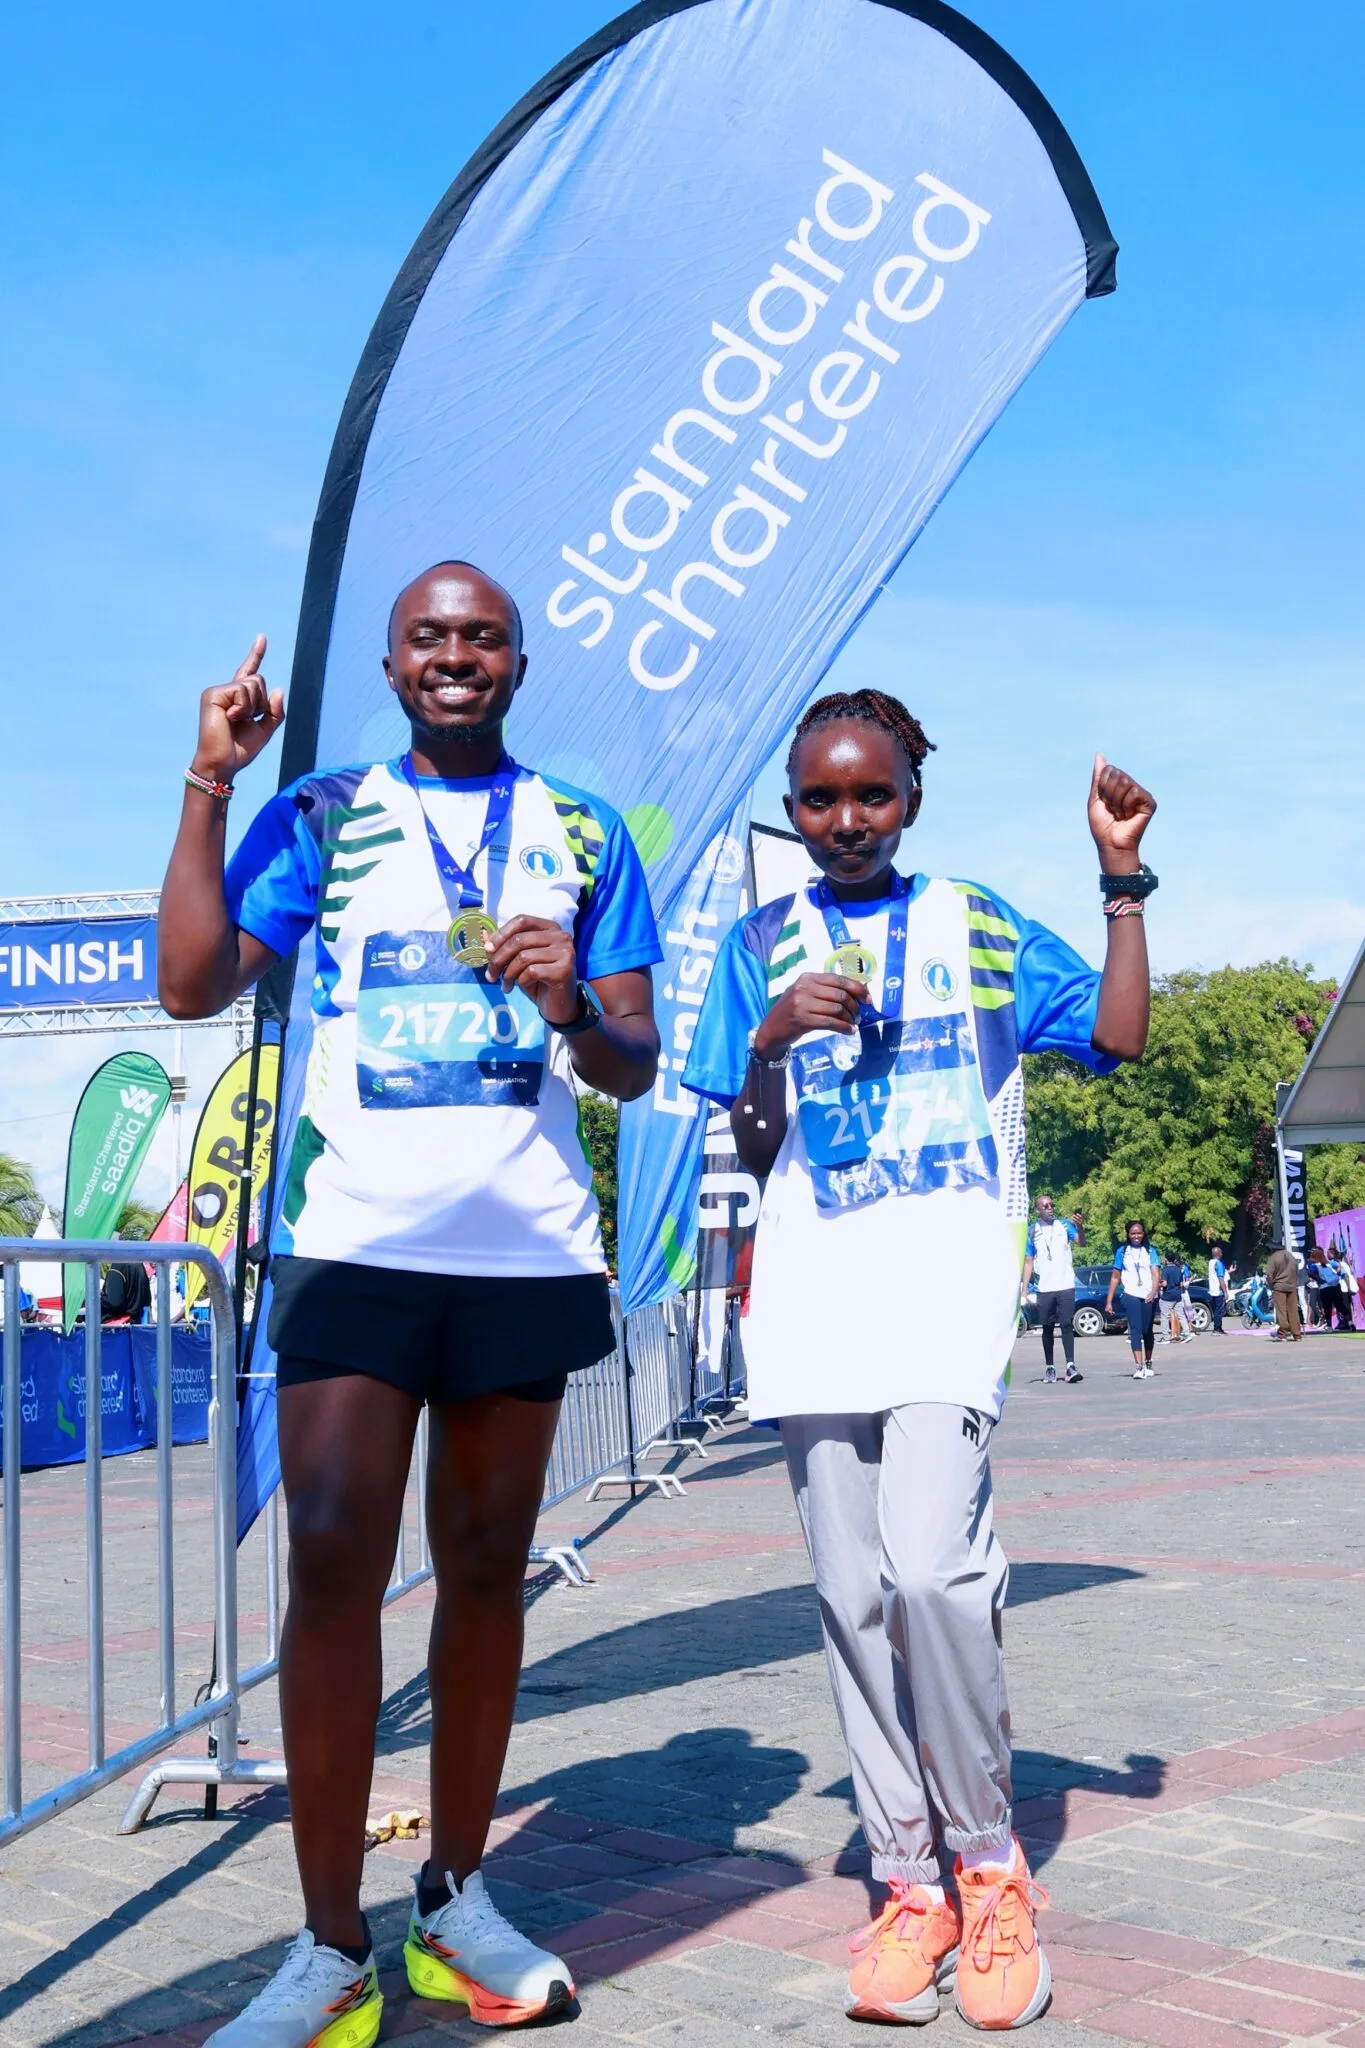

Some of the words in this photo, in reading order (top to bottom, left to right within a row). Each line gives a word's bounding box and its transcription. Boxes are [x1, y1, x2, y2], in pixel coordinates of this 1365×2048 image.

[546, 147, 895, 649] standard
[628, 172, 992, 691] chartered
[74, 1165, 102, 1217] Standard
[96, 1111, 124, 1166] Chartered
[379, 1001, 520, 1048] 21720
